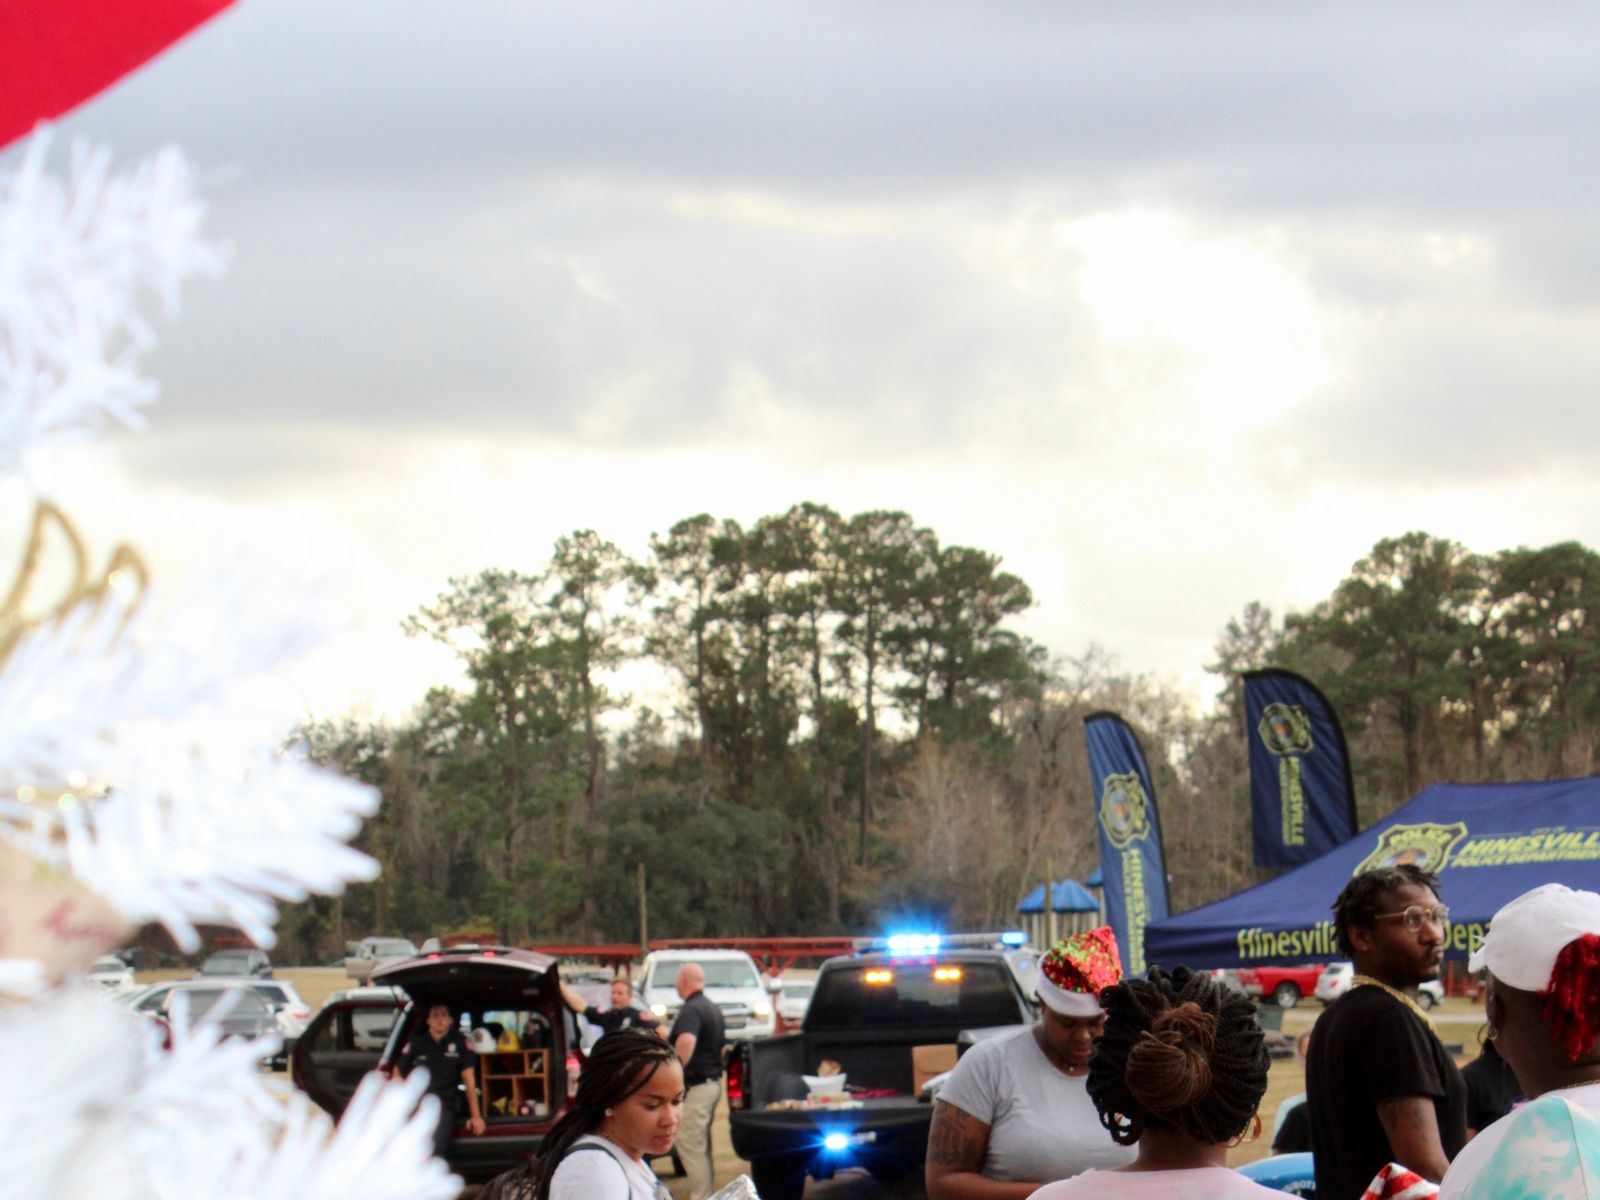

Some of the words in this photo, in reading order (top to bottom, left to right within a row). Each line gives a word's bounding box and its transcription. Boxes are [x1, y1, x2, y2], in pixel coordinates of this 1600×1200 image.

[1459, 832, 1600, 856] HINESVILL
[1506, 850, 1600, 863] DEPARTMEN
[1237, 919, 1337, 959] Hinesvill
